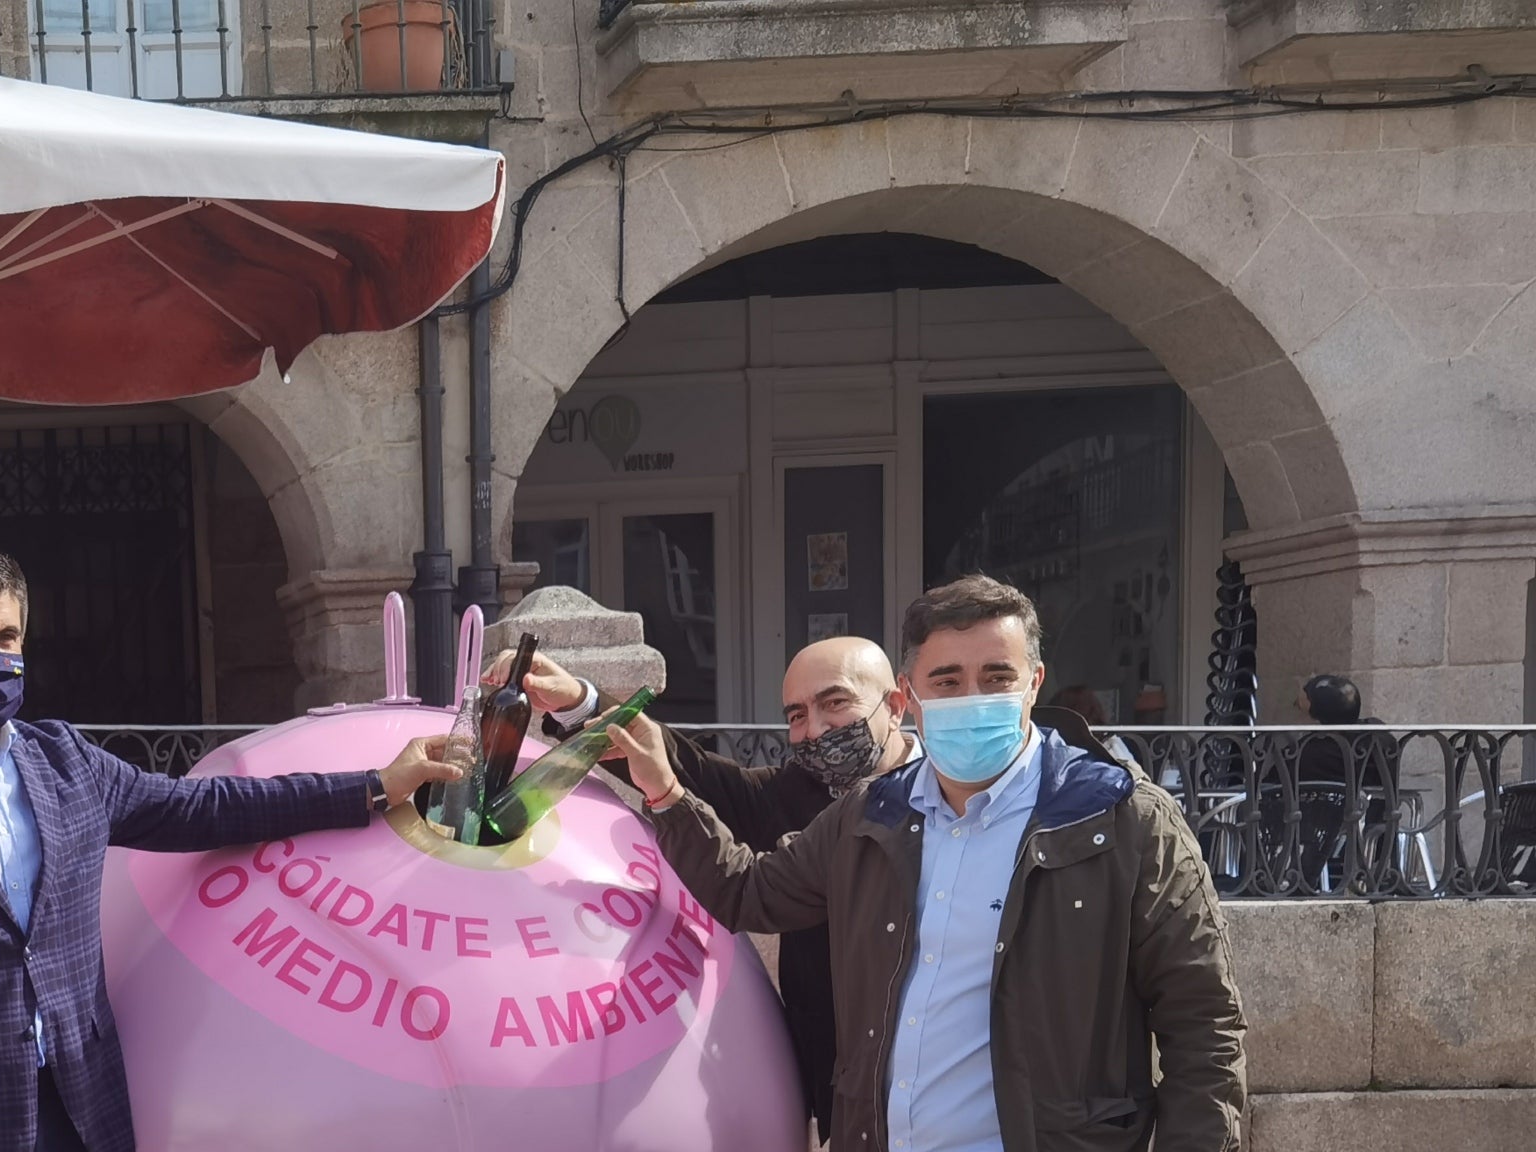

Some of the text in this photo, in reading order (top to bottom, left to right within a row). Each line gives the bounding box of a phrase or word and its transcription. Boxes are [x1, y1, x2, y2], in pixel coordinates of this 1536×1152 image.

[198, 865, 714, 1047] O MEDIO AMBIENTE
[516, 916, 560, 959] E
